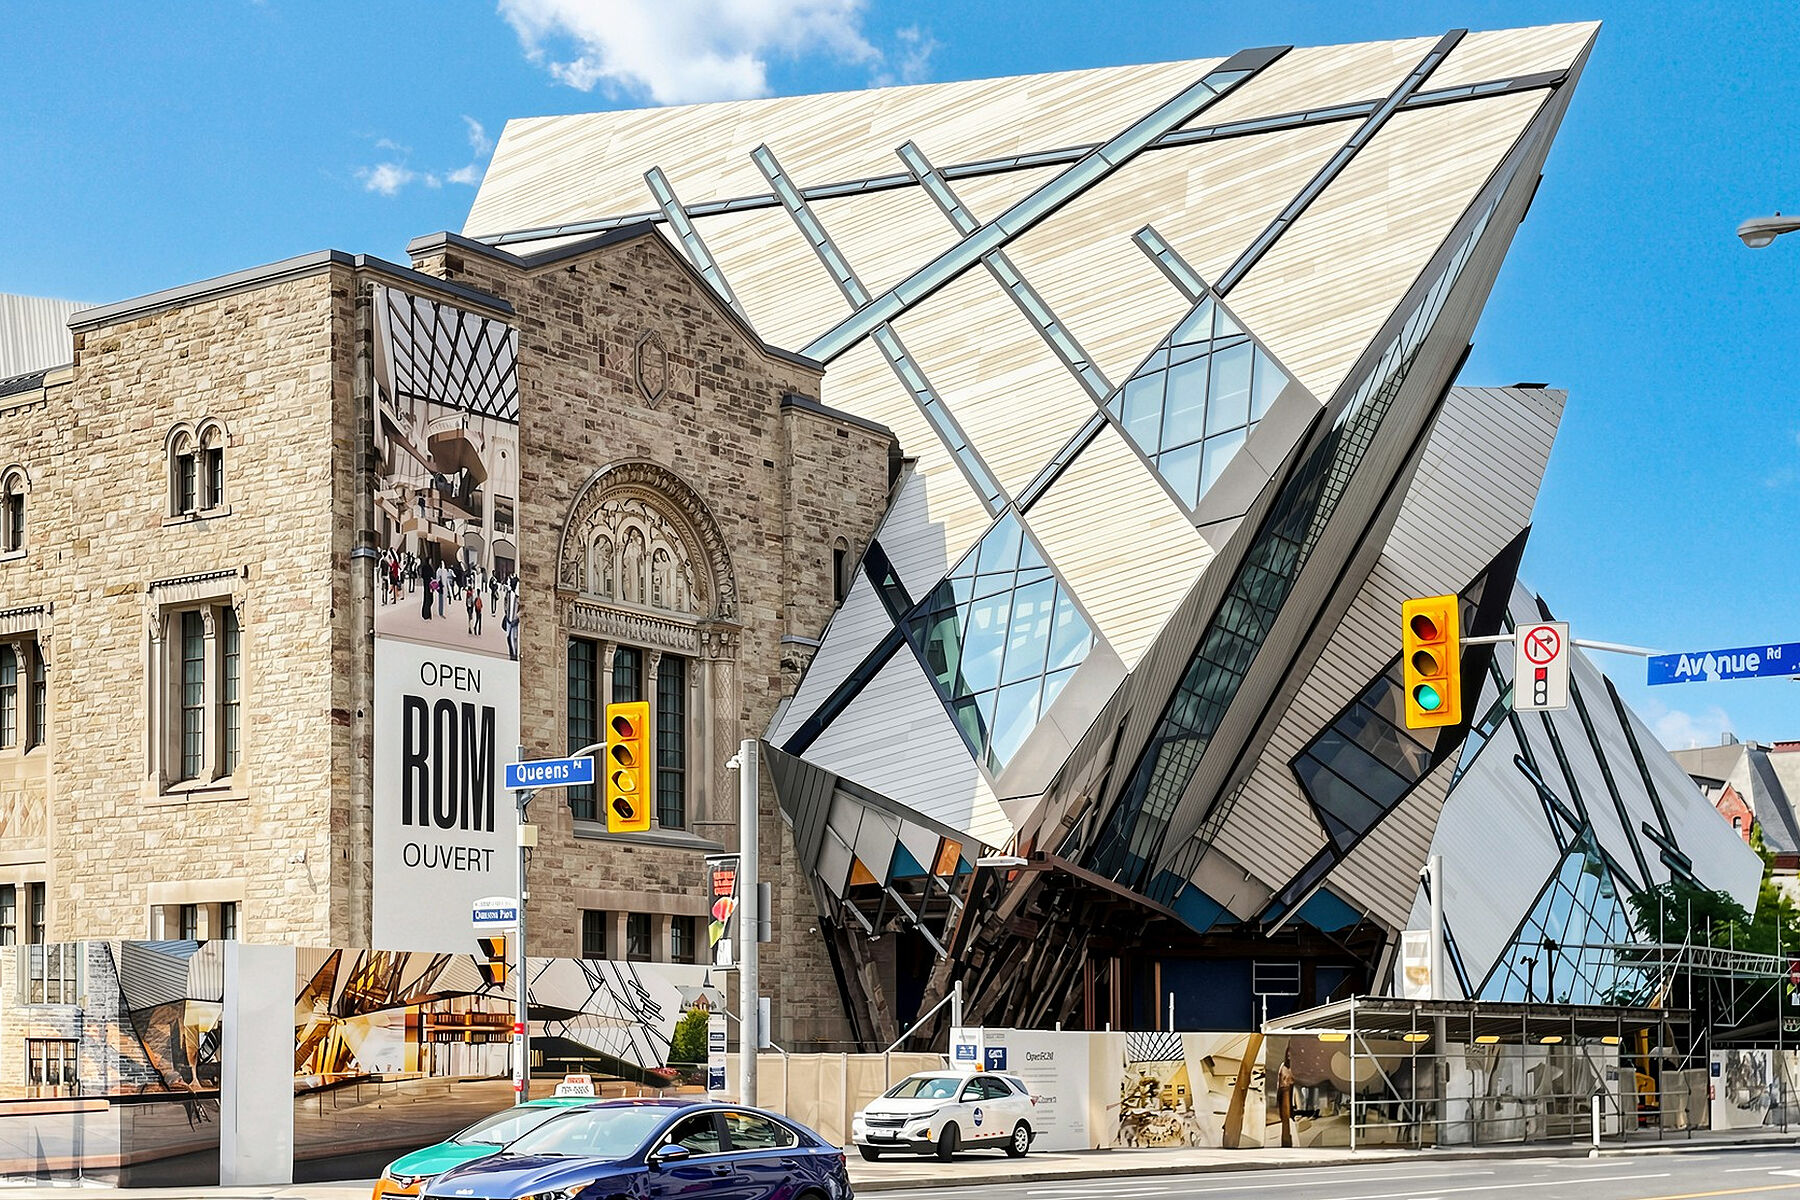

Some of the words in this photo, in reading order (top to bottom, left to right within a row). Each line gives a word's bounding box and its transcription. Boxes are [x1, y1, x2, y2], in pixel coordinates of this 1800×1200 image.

[1766, 647, 1781, 660] Rd
[420, 661, 481, 693] OPEN
[402, 694, 495, 832] ROM
[516, 764, 569, 783] Queens
[403, 842, 494, 872] OUVERT
